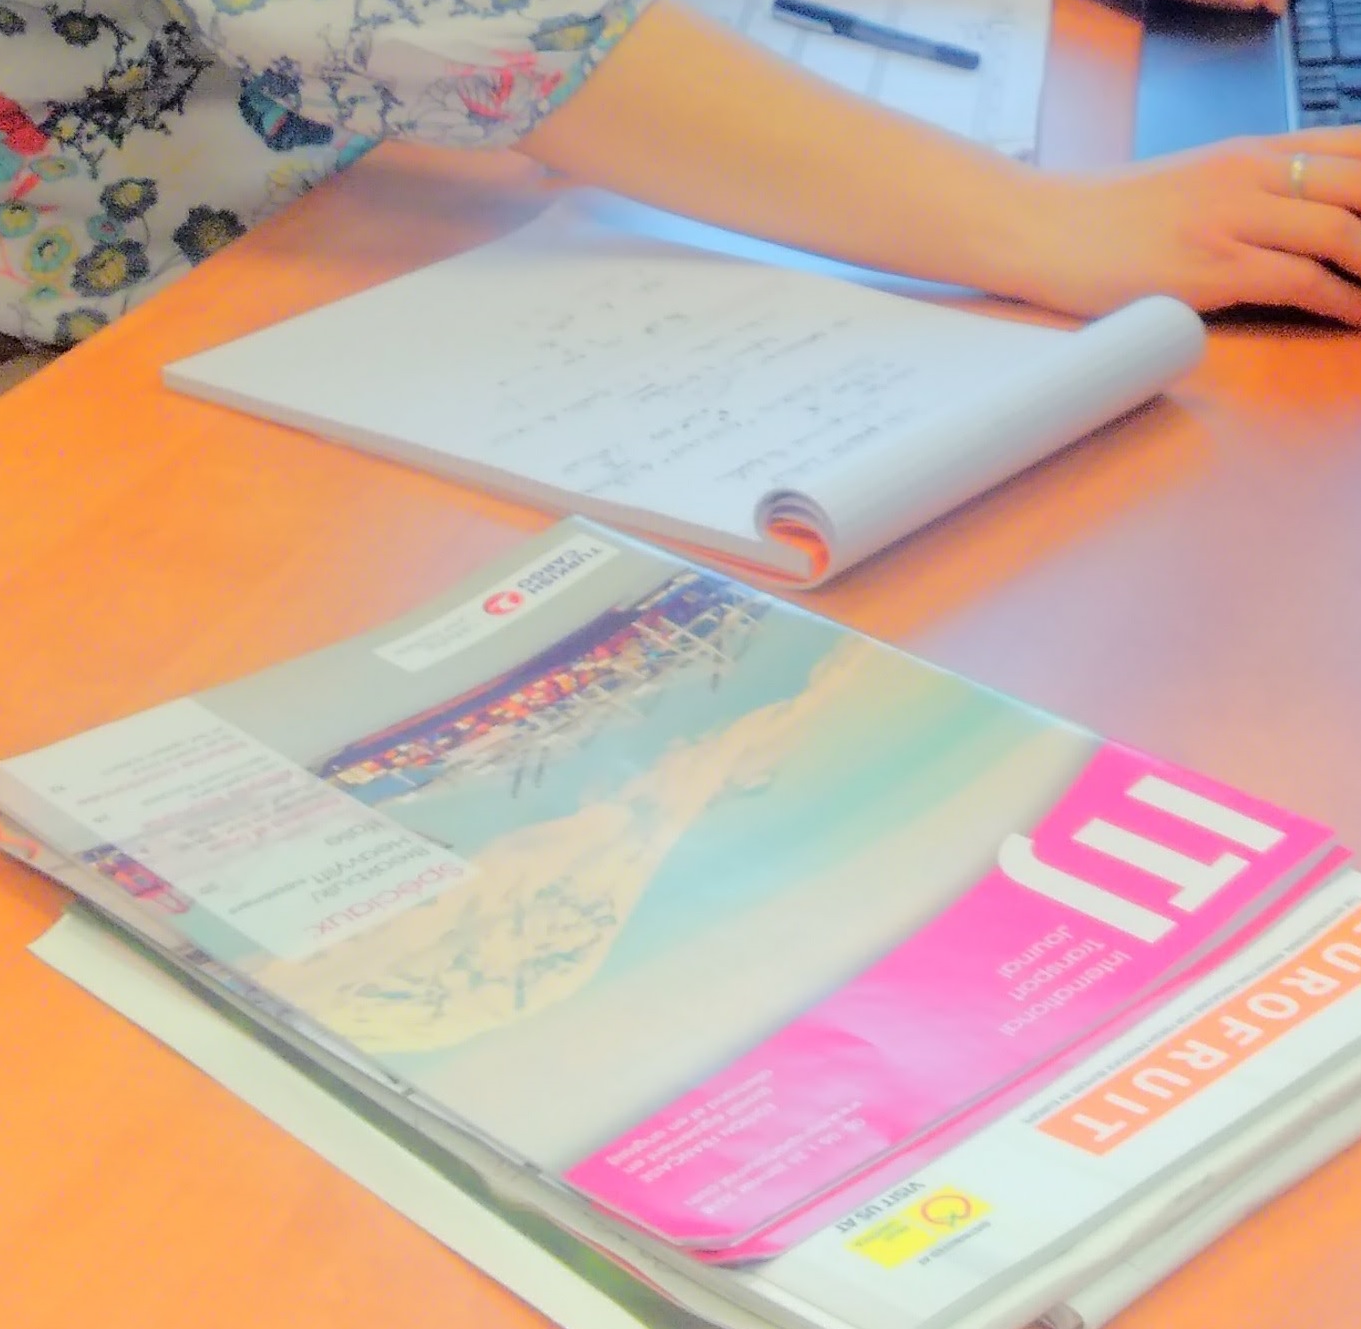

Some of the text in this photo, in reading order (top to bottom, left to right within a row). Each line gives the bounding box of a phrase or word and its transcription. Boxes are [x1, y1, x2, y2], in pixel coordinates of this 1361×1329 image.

[997, 774, 1287, 942] ITJ
[991, 924, 1083, 980] Journal
[1000, 936, 1108, 1002] Transport
[994, 949, 1134, 1038] International
[833, 1179, 925, 1233] VISIT US AT
